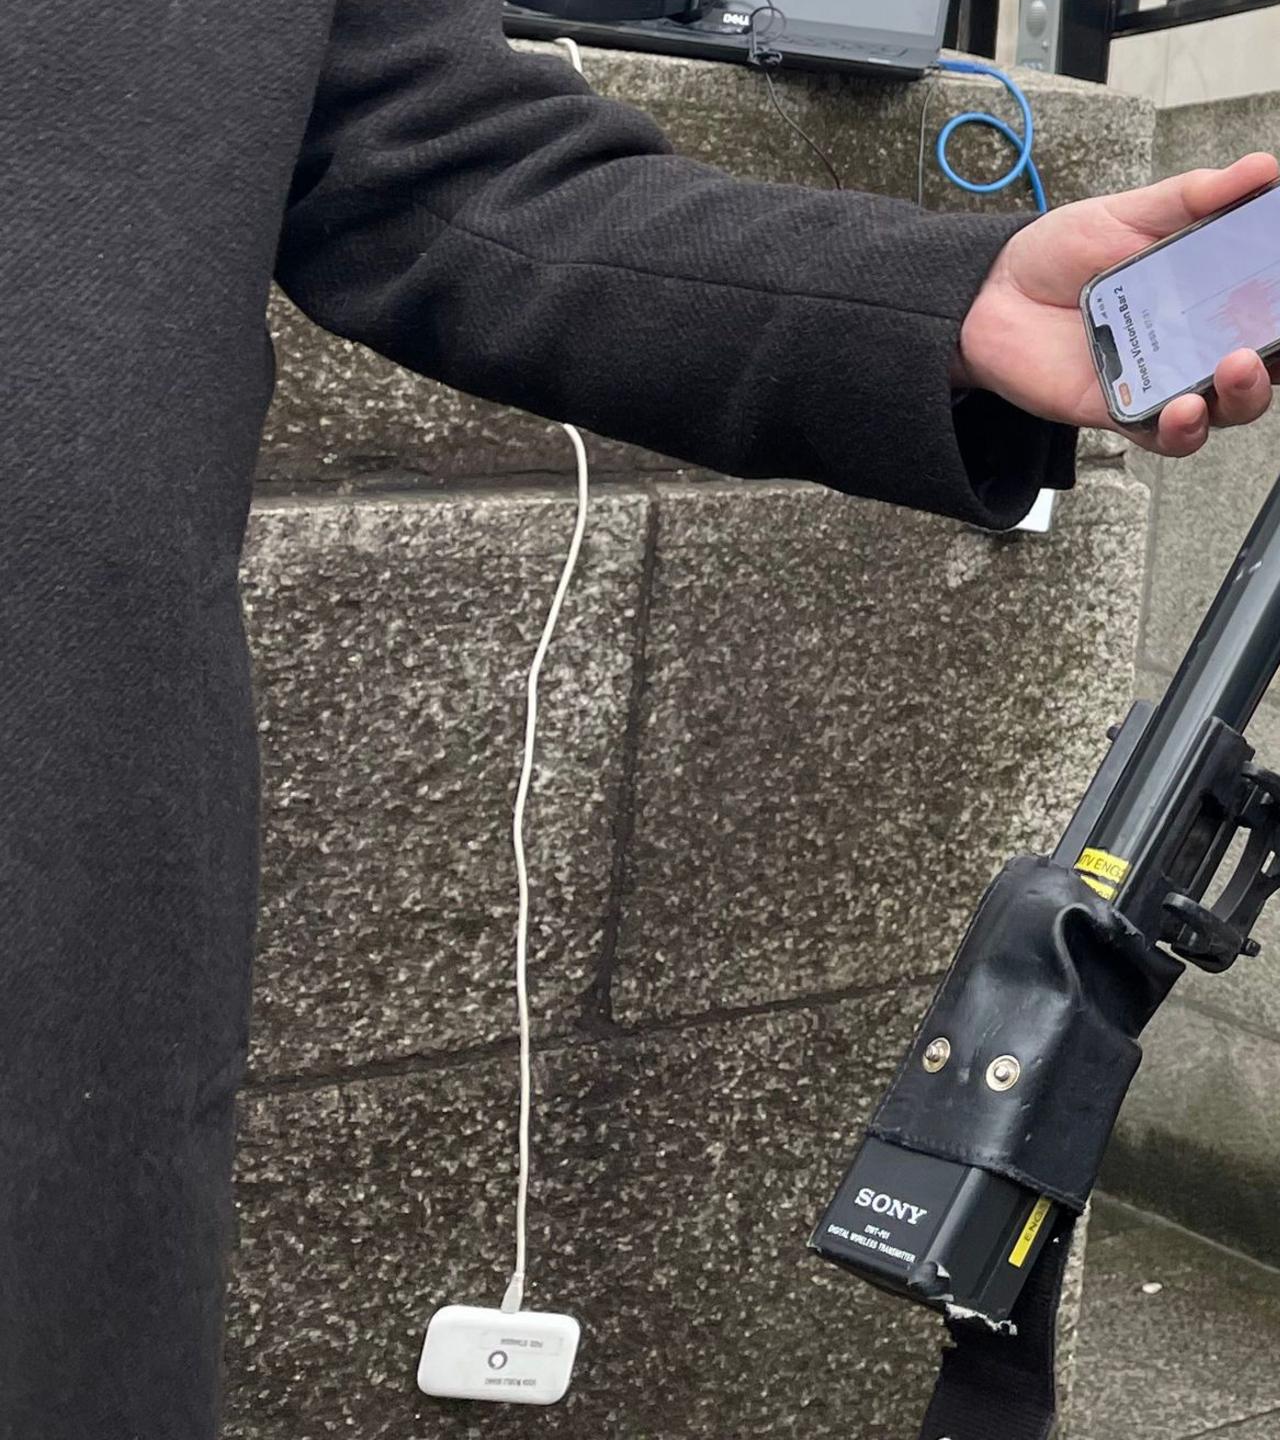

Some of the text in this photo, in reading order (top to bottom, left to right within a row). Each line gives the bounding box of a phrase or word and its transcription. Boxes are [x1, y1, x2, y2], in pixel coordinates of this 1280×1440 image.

[1113, 285, 1153, 393] Toners Victorian Bar 2
[854, 1187, 928, 1225] SONY
